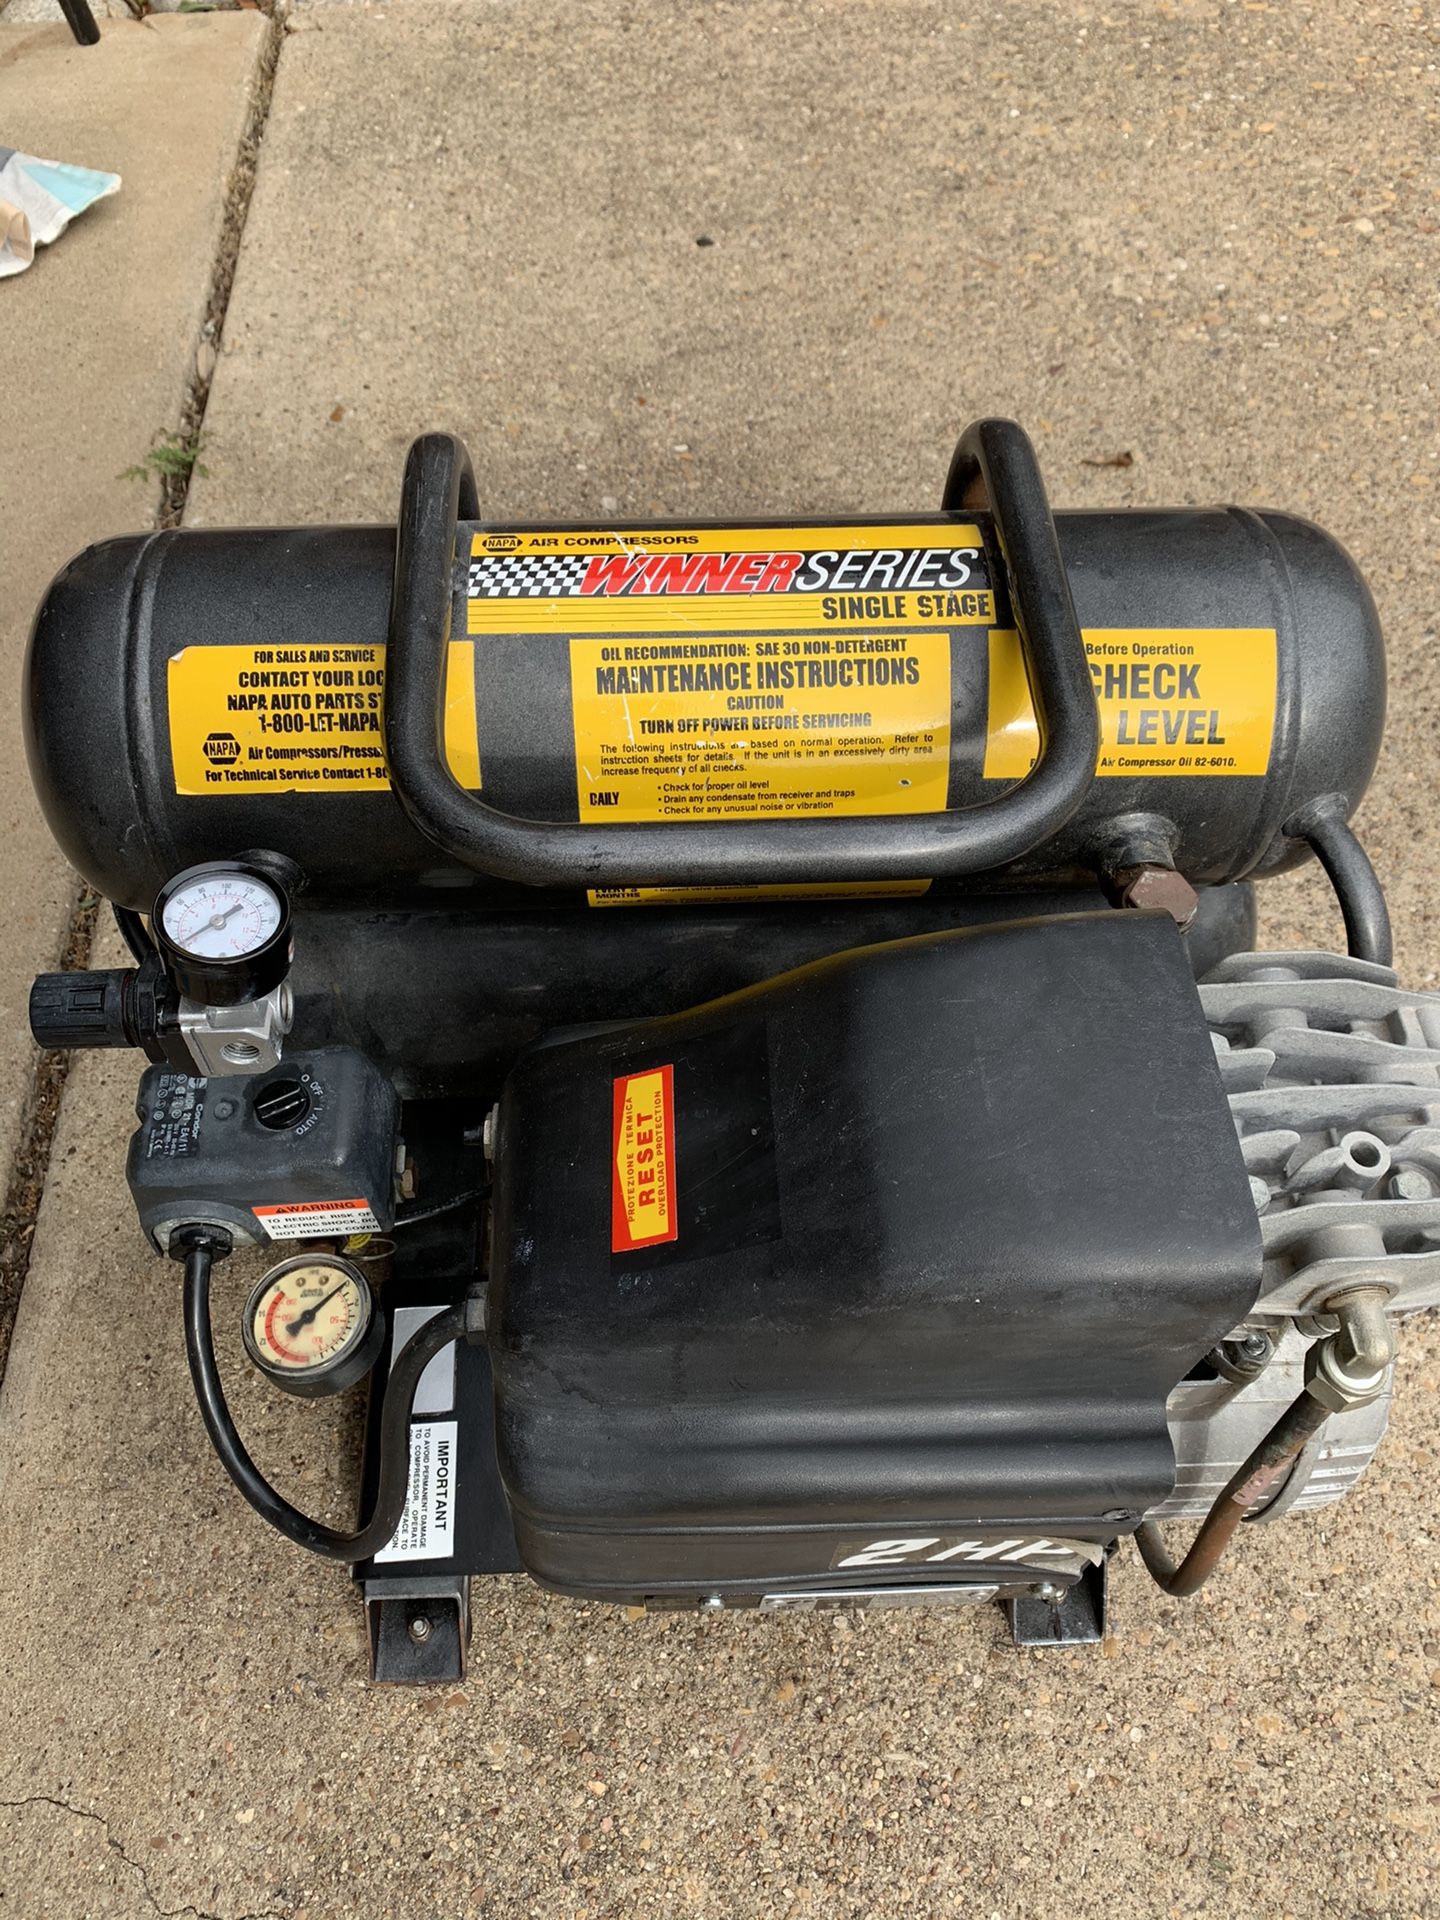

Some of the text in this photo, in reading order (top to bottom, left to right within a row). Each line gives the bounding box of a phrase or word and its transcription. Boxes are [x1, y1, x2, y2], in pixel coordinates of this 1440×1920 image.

[487, 535, 699, 549] NAPA AIR COMPRESSORS
[582, 549, 979, 595] WINNER SERIES
[823, 593, 991, 620] SINGLE STAGE
[254, 649, 375, 663] FOR SALES AND SERVICE
[601, 639, 908, 661] OIL RECOMMENDATION: SAE 30 NON-DETERGENT
[1086, 642, 1194, 658] Before Operation
[239, 672, 309, 688] CONTACT
[313, 671, 355, 686] YOUR
[596, 657, 920, 695] MAINTENANCE INSTRUCTIONS
[227, 694, 267, 711] NAPA
[271, 694, 311, 710] AUTO
[315, 693, 363, 709] PARTS
[727, 695, 784, 710] CAUTION
[258, 712, 380, 734] 1-800-LET-NAPA
[640, 712, 872, 735] TURN OFF POWER BEFORE SERVICING
[1116, 710, 1226, 745] LEVEL
[208, 742, 385, 762] NAPA Air Compressors/Pressu
[600, 744, 619, 754] The
[622, 742, 667, 755] following
[750, 739, 778, 750] based
[800, 737, 833, 748] normal
[838, 736, 884, 747] operation.
[894, 734, 920, 744] Refer
[923, 733, 934, 743] to
[601, 754, 650, 765] instruction
[653, 752, 682, 763] sheets
[687, 752, 701, 762] for
[744, 750, 752, 760] If
[754, 749, 770, 760] the
[774, 748, 792, 759] unit
[794, 748, 803, 758] is
[806, 748, 815, 758] in
[819, 749, 830, 757] an
[834, 746, 886, 758] excessively
[889, 744, 909, 756] dirty
[914, 746, 933, 754] area
[1101, 757, 1237, 769] Air Compressor Oil 82-6010.
[205, 770, 222, 781] For
[224, 769, 277, 781] Technical
[279, 768, 320, 780] Service
[322, 768, 364, 780] Contact
[601, 766, 640, 777] increase
[642, 765, 686, 777] frequency
[688, 764, 698, 774] of
[700, 764, 711, 774] all
[663, 779, 770, 794] Check for proper oil level
[589, 792, 620, 806] DAILY
[663, 789, 856, 805] Drain any condensate from receiver and traps
[664, 800, 834, 816] Check for any unusual noise or vibration
[310, 1082, 324, 1098] OFF
[184, 1092, 195, 1110] MDR
[192, 1103, 203, 1139] Condor
[296, 1114, 319, 1136] AUTO
[626, 1096, 636, 1222] PROTEZIONE TERMICA
[636, 1112, 656, 1207] RESET
[654, 1090, 666, 1216] OVERLOAD PROTECTION
[286, 1202, 356, 1214] WARNING
[271, 1222, 318, 1231] ELECTRIC
[300, 1228, 343, 1236] REMOVE
[415, 1428, 422, 1440] TO
[411, 1444, 422, 1504] COMPRESSOR,
[420, 1428, 431, 1549] TO AVOID PERMANENT DAMAGE
[435, 1440, 450, 1531] IMPORTANT
[410, 1510, 419, 1549] OPERATE
[400, 1539, 408, 1551] TO
[837, 1538, 940, 1567] 2
